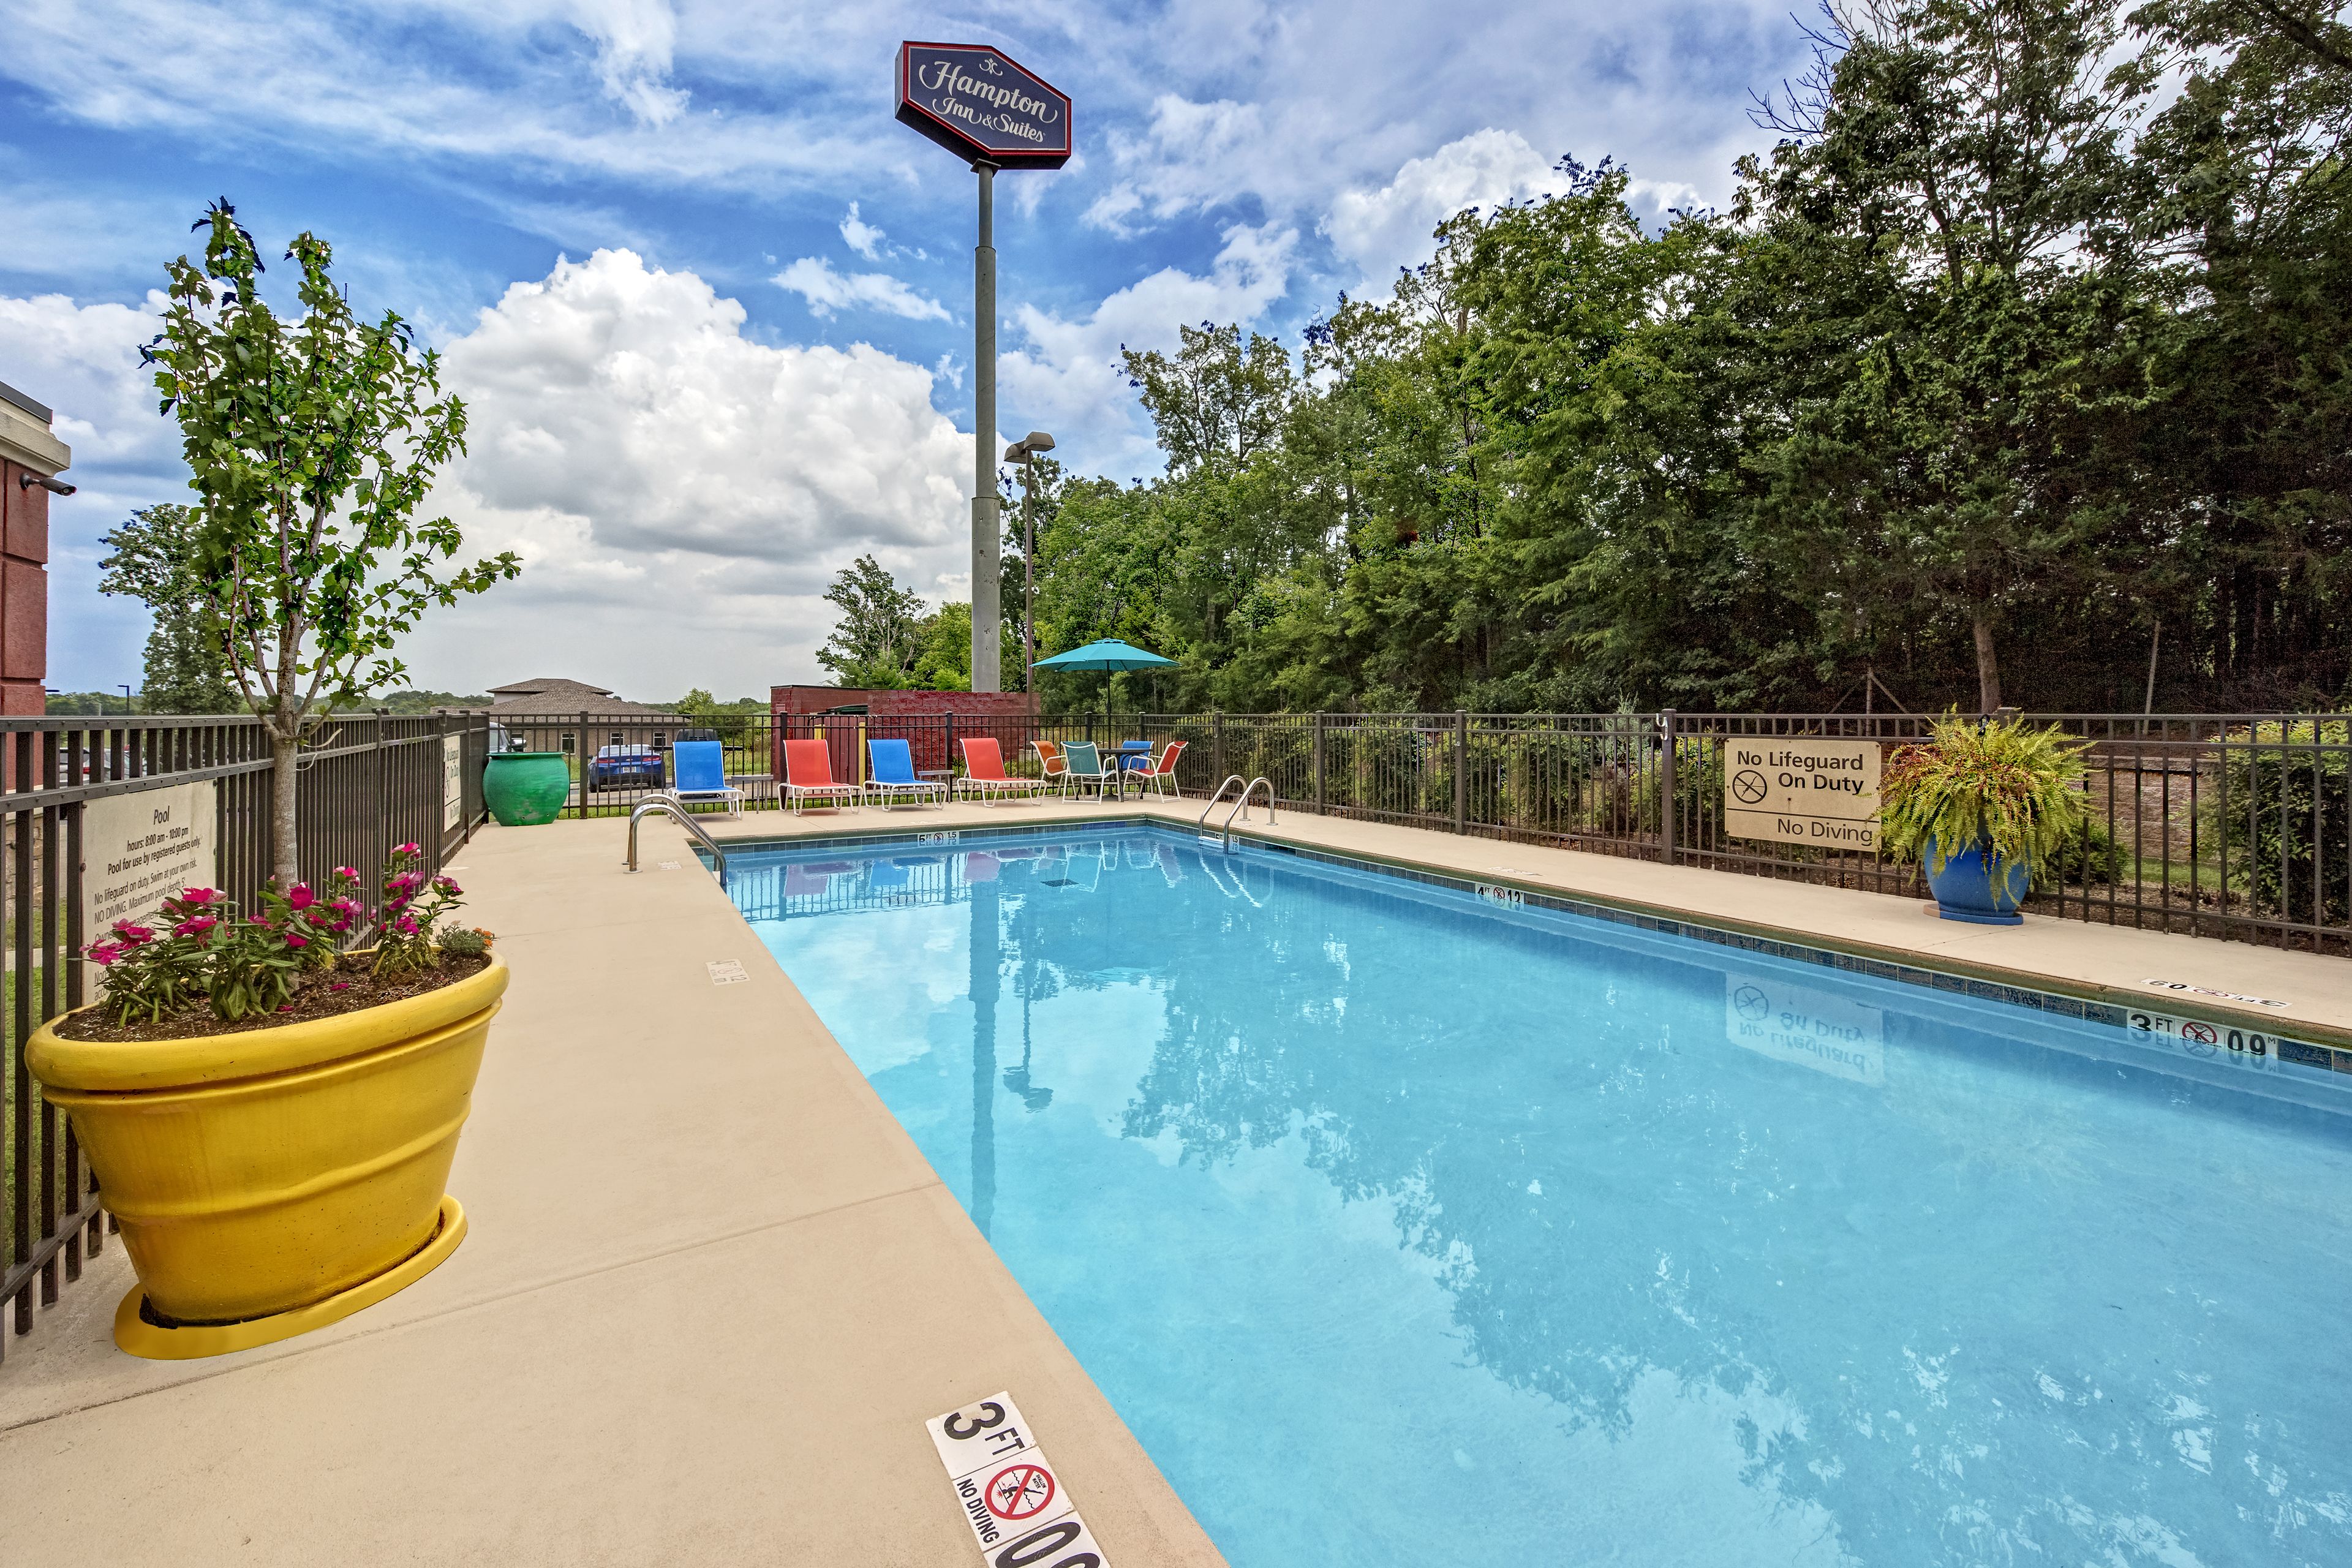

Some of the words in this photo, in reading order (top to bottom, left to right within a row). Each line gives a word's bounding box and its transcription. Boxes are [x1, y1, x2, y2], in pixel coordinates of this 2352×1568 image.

[919, 61, 1058, 123] Hampton
[932, 97, 982, 124] Inn
[982, 114, 995, 130] &
[993, 114, 1044, 142] Suites
[1737, 750, 1762, 766] No
[1769, 751, 1864, 772] Lifeguard
[1778, 772, 1806, 789] On
[1814, 774, 1864, 795] Duty
[153, 805, 170, 825] Pool
[1777, 818, 1804, 835] No
[1811, 821, 1873, 846] Diving
[108, 859, 121, 875] Pool
[123, 858, 132, 870] for
[132, 856, 142, 867] use
[143, 852, 150, 865] by
[151, 843, 175, 862] registered
[176, 840, 190, 856] guests
[191, 835, 201, 848] only.
[127, 840, 145, 852] hours:
[145, 834, 156, 846] 8:00
[157, 834, 165, 843] am
[169, 827, 181, 840] 10:00
[181, 827, 189, 839] pm
[94, 892, 104, 906] No
[104, 881, 129, 902] lifeguard
[129, 882, 137, 892] on
[137, 876, 149, 889] duty.
[150, 870, 164, 884] Swim
[164, 869, 169, 879] at
[169, 865, 179, 880] your
[179, 862, 189, 872] own
[94, 910, 105, 925] NO
[106, 900, 127, 920] DIVING.
[129, 892, 154, 910] Maximum
[155, 883, 167, 902] pool
[167, 878, 181, 894] depth
[2130, 1013, 2152, 1032] 3
[2155, 1017, 2173, 1033] FT
[2267, 1036, 2276, 1045] M
[944, 1402, 1006, 1440] 3
[984, 1427, 1025, 1455] FT
[956, 1478, 978, 1498] NO
[966, 1497, 1000, 1544] DIVING
